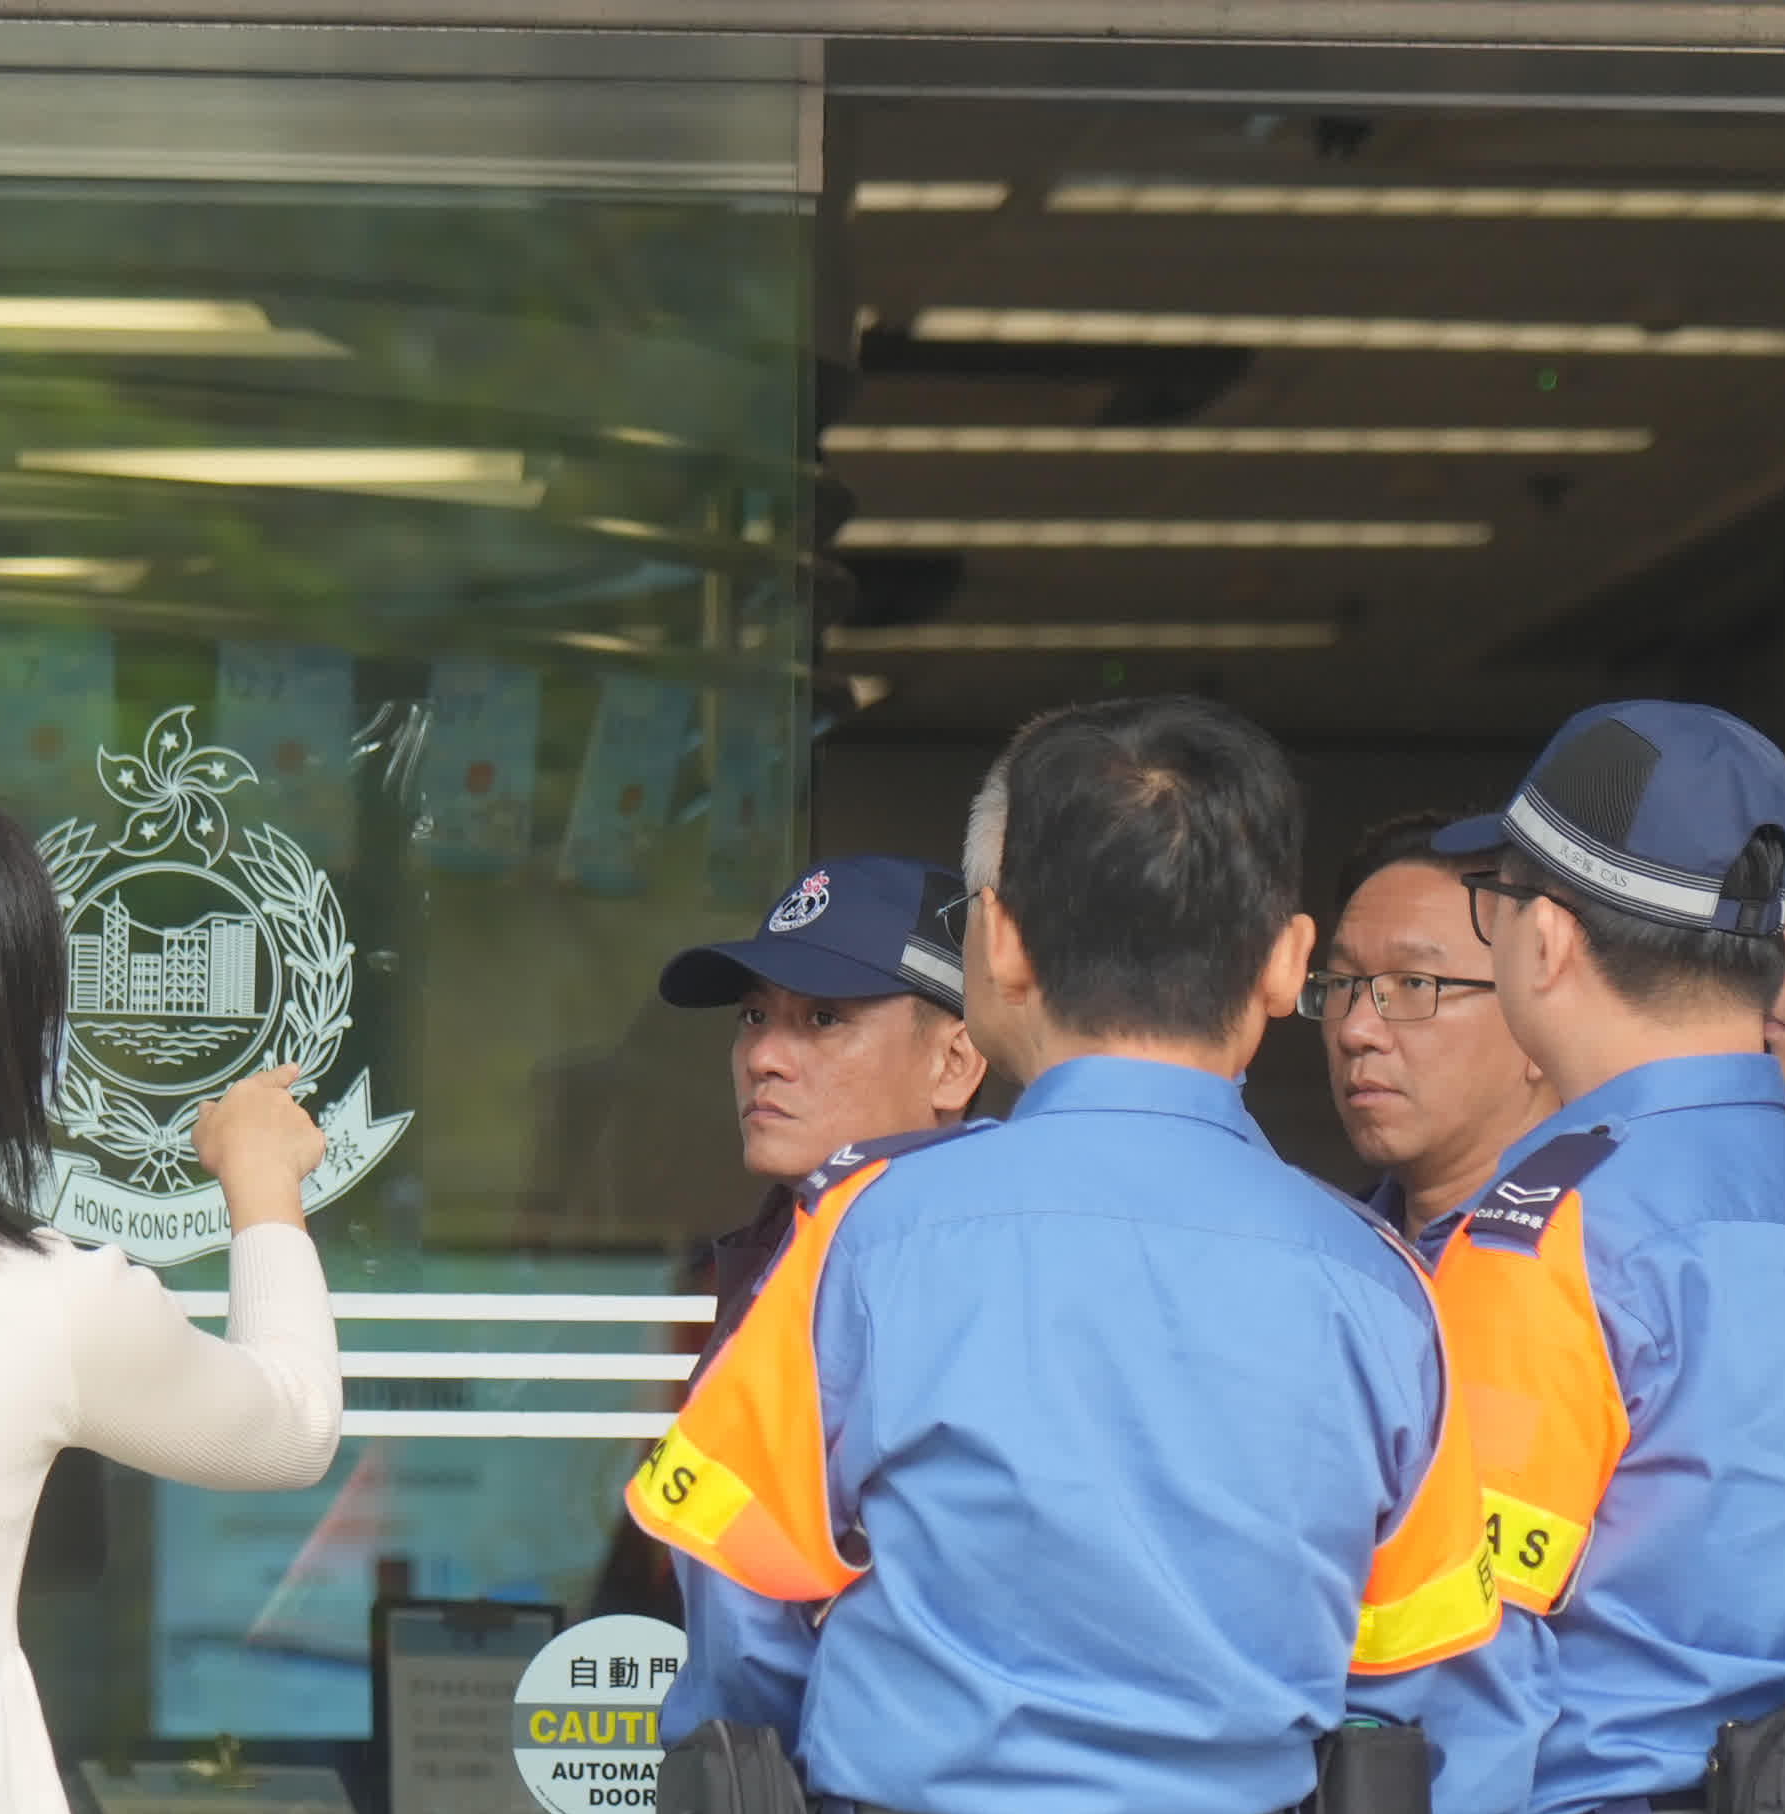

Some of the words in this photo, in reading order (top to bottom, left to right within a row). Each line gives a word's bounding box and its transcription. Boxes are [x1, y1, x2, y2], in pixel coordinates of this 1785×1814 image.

[74, 1192, 123, 1234] HONG
[128, 1211, 178, 1240] KONG
[183, 1206, 232, 1238] POLIC
[647, 1439, 697, 1505] AS
[1486, 1512, 1550, 1570] AS
[571, 1656, 679, 1689] 自動門
[529, 1709, 657, 1744] CAUTI
[552, 1762, 660, 1781] AUTOMA
[589, 1788, 657, 1806] DOOR
